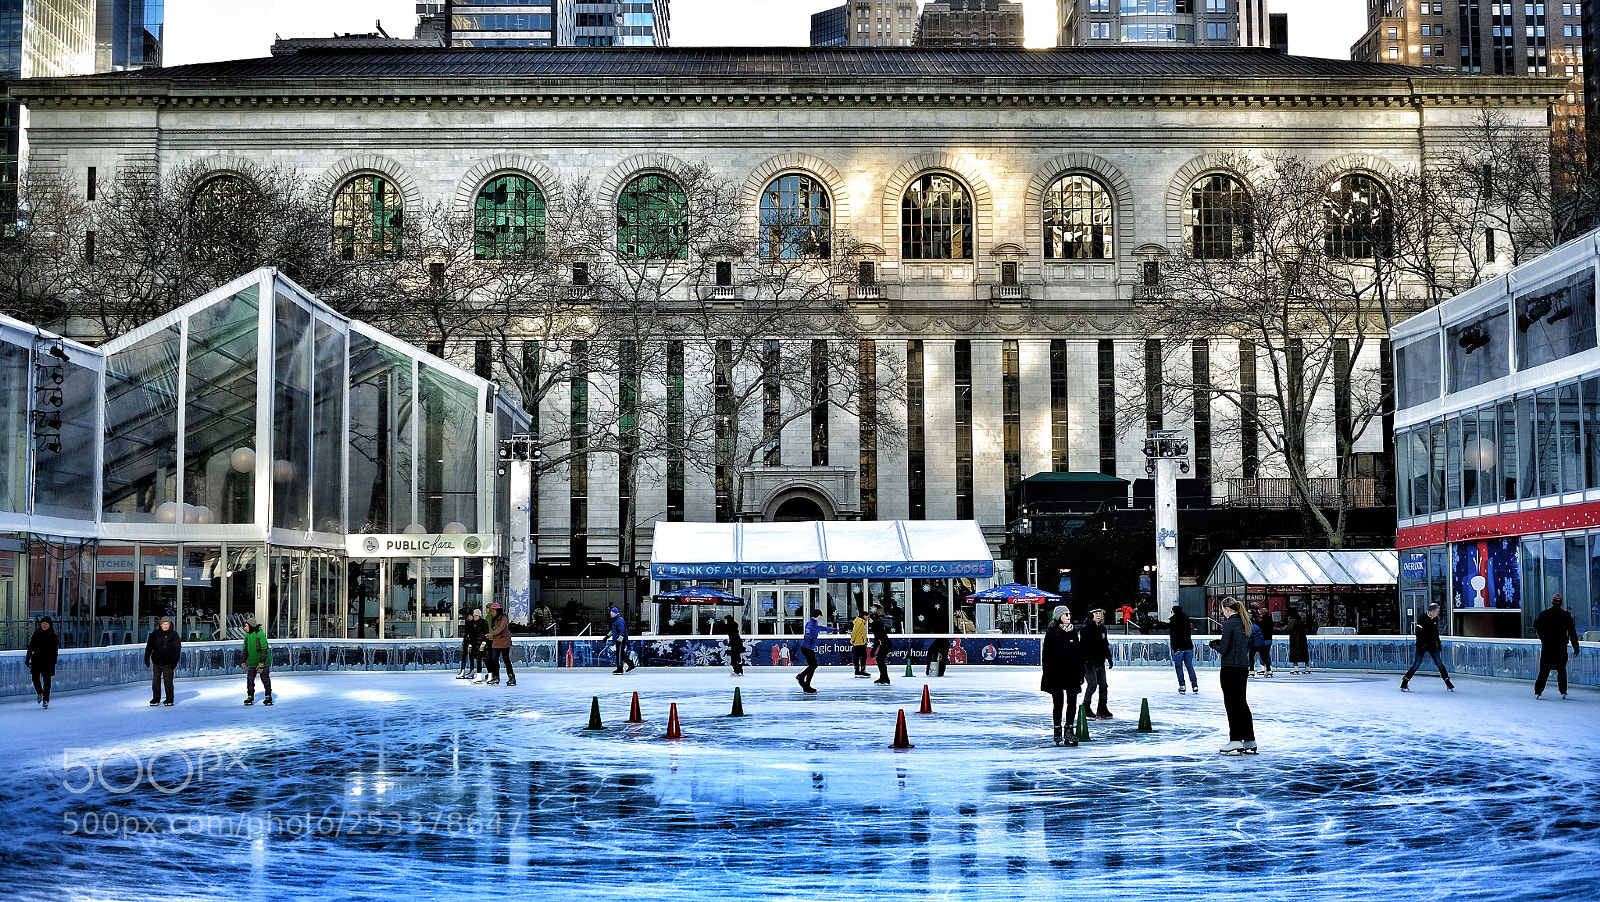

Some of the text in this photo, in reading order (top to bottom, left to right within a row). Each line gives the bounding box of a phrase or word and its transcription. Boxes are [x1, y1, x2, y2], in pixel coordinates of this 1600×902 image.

[386, 535, 455, 556] PUBLIC fare
[97, 560, 134, 568] ITCHEN
[670, 564, 817, 575] BANK OF AMERICA LODGE
[841, 563, 986, 574] BANK OF AMERICA LODGE
[813, 643, 854, 655] agic hour
[887, 648, 929, 659] every hour
